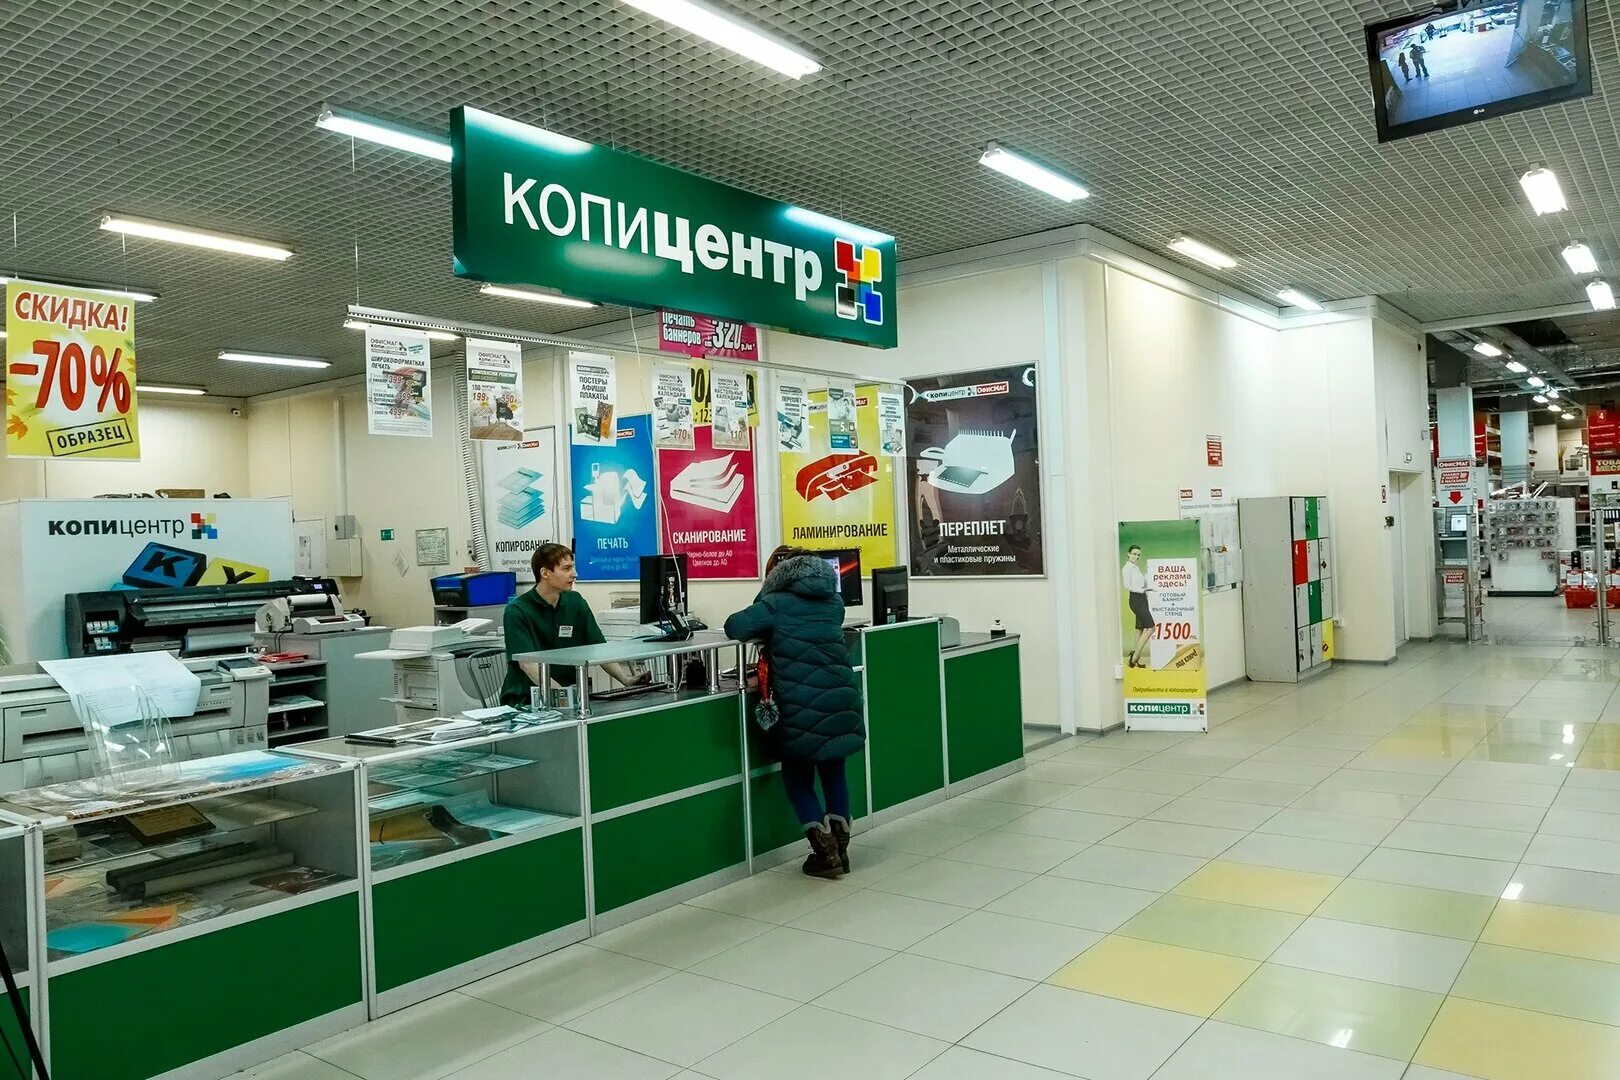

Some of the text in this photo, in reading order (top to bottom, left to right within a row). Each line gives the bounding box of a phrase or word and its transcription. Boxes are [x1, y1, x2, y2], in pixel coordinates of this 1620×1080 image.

[15, 291, 128, 332] СКИДКА!
[662, 324, 702, 346] баннеров
[371, 356, 425, 366] ШИРОКОФОРМАТНАЯ
[10, 340, 131, 414] -70%
[388, 376, 402, 384] 399
[579, 376, 608, 385] ПОСТЕРЫ
[582, 384, 606, 392] АФИШИ
[473, 392, 486, 401] 199
[502, 394, 514, 403] 550
[580, 392, 608, 400] ПЛАКАТЫ
[930, 389, 966, 398] копицентр
[389, 408, 402, 416] 499
[57, 425, 125, 448] ОБРАЗЕЦ
[48, 517, 184, 538] копицентр
[792, 524, 888, 539] ЛАМИНИРОВАНИЕ
[939, 520, 1006, 536] ПЕРЕПЛЕТ
[672, 529, 746, 544] СКАНИРОВАНИЕ
[597, 537, 629, 550] ПЕЧАТЬ
[984, 555, 1016, 564] пружины
[1158, 580, 1187, 588] здесь!
[1156, 622, 1191, 640] 1500
[1130, 704, 1188, 714] копицентр
